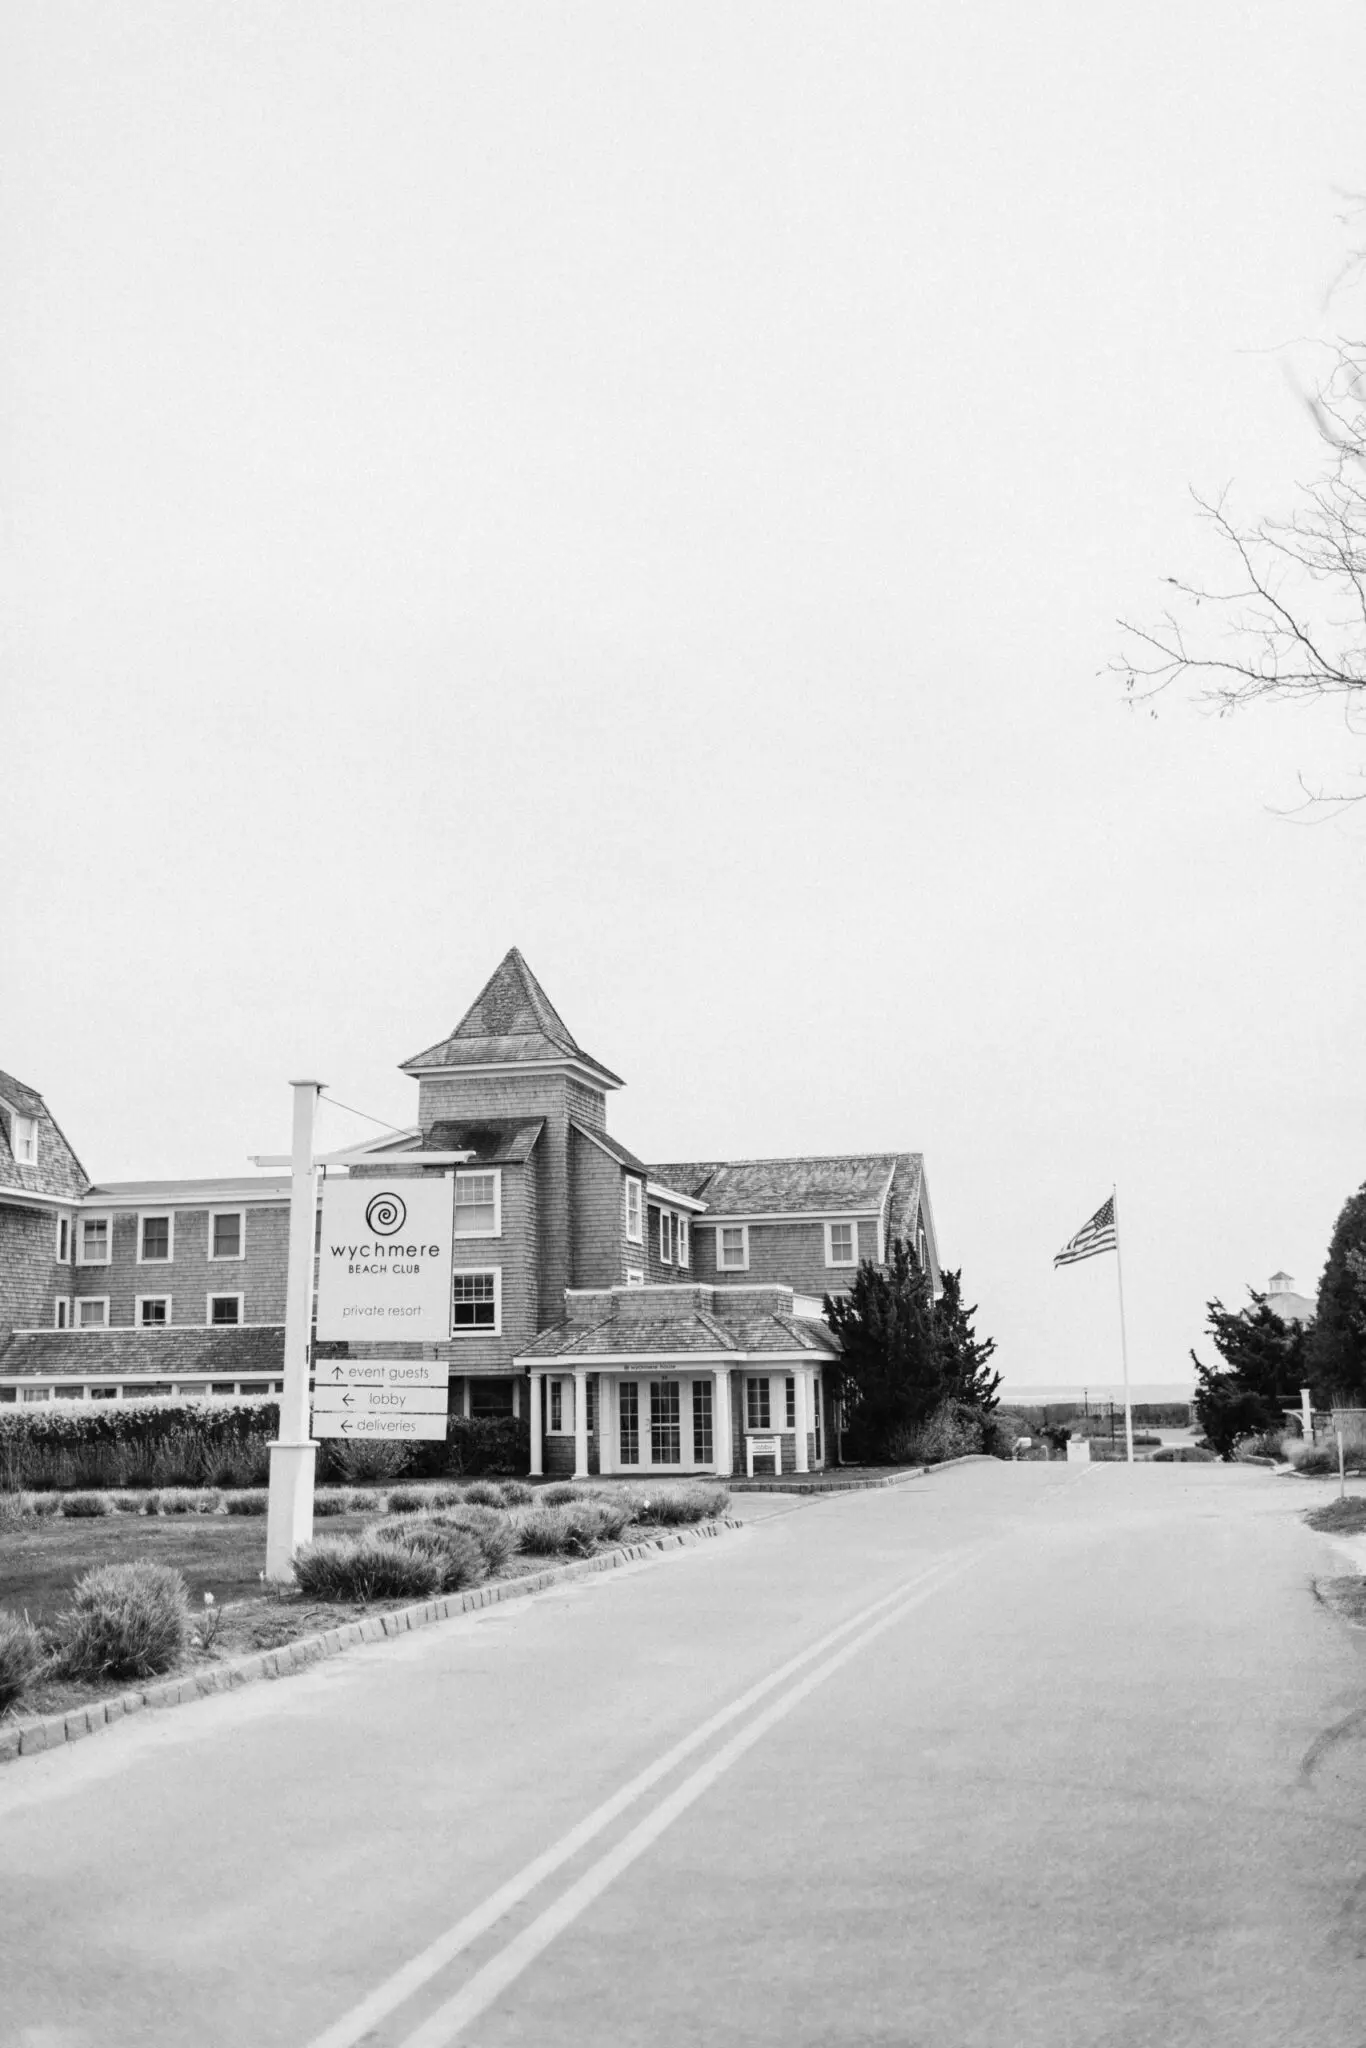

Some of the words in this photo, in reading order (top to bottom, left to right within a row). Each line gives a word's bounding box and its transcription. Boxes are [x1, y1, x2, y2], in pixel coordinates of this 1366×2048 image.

[330, 1241, 440, 1261] wychmere
[348, 1264, 387, 1274] BEACH
[392, 1264, 420, 1274] CLUB
[342, 1304, 385, 1318] private
[387, 1305, 422, 1316] resort
[348, 1366, 385, 1378] event
[388, 1367, 430, 1380] guests
[369, 1392, 407, 1407] lobby
[356, 1419, 417, 1432] deliveries
